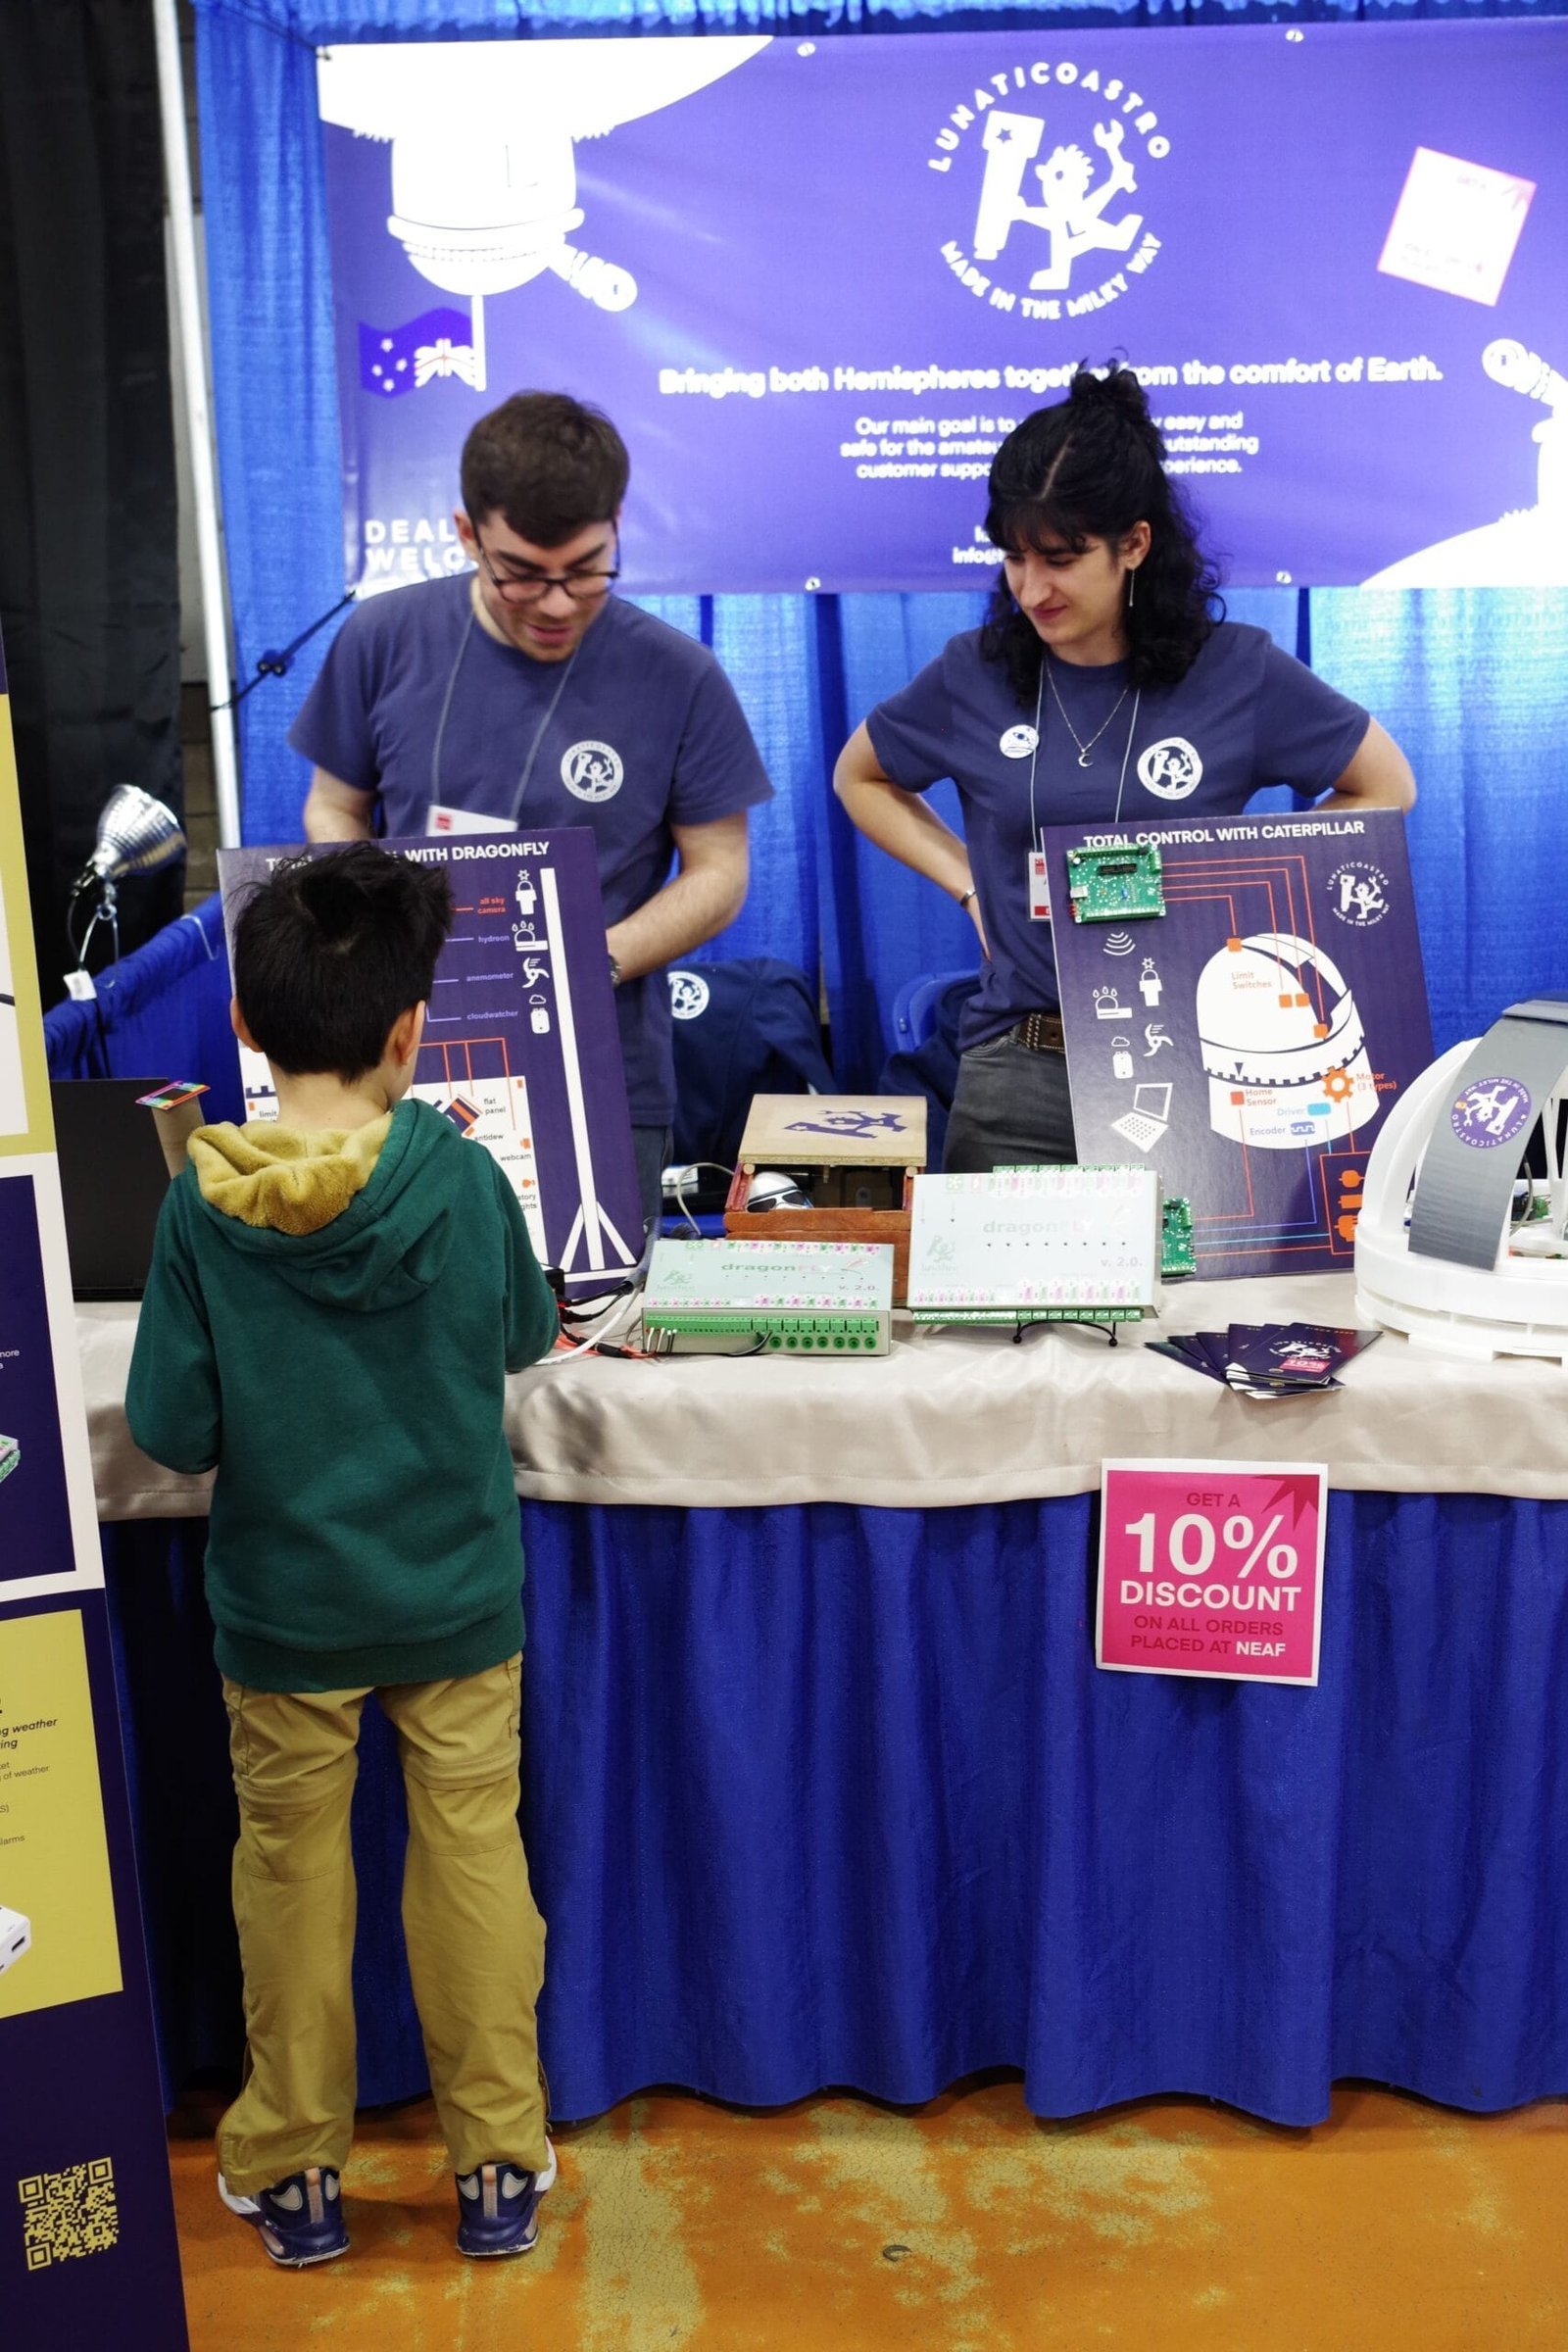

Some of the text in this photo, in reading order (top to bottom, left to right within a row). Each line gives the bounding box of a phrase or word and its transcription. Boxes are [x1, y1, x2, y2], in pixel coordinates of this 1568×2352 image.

[928, 62, 1171, 172] LUNATICOASTRO
[989, 287, 1016, 312] IN
[1020, 297, 1061, 319] THE
[1066, 272, 1128, 318] MILKY
[1126, 232, 1162, 274] WAY
[659, 367, 766, 399] Bringing
[769, 366, 829, 392] both
[834, 364, 1001, 396] Hemispheres
[1182, 359, 1226, 385] the
[1229, 357, 1333, 384] comfort
[1335, 356, 1363, 383] of
[1367, 354, 1444, 382] Earth.
[855, 416, 890, 436] Our
[892, 416, 936, 435] main
[938, 416, 977, 438] goal
[980, 416, 995, 433] is
[998, 416, 1016, 433] to
[1163, 415, 1207, 434] easy
[1208, 410, 1244, 430] and
[840, 433, 1259, 458] safe for the amateu utstanding
[856, 462, 938, 479] customer
[1160, 456, 1243, 475] perience.
[364, 517, 457, 544] DEAL
[365, 546, 467, 571] WELC
[1083, 820, 1366, 848] TOTAL CONTROL WITH CATERPILLAR
[404, 848, 448, 863] WITH
[452, 841, 550, 860] DRAGONFLY
[479, 897, 506, 906] all sky
[477, 906, 507, 915] camera
[466, 972, 514, 983] anemometer
[1231, 971, 1254, 981] Limit
[1232, 980, 1272, 990] Switches
[466, 1009, 518, 1020] cloudwatcher
[1356, 1071, 1385, 1081] Motor
[1246, 1088, 1273, 1097] Home
[1370, 1081, 1397, 1092] types)
[1246, 1098, 1277, 1106] Sensor
[485, 1106, 507, 1115] panel
[1277, 1106, 1305, 1116] Driver
[1250, 1126, 1286, 1136] Encoder
[500, 1152, 532, 1162] webcam
[1186, 1492, 1241, 1507] GET A
[1125, 1512, 1298, 1579] 10%
[1120, 1580, 1301, 1612] DISCOUNT
[1134, 1615, 1284, 1637] ON ALL ORDERS
[1131, 1635, 1286, 1657] PLACED AT NEAF
[13, 1718, 58, 1734] weather
[3, 1771, 13, 1781] of
[14, 1765, 50, 1779] weather
[0, 1834, 25, 1846] larms
